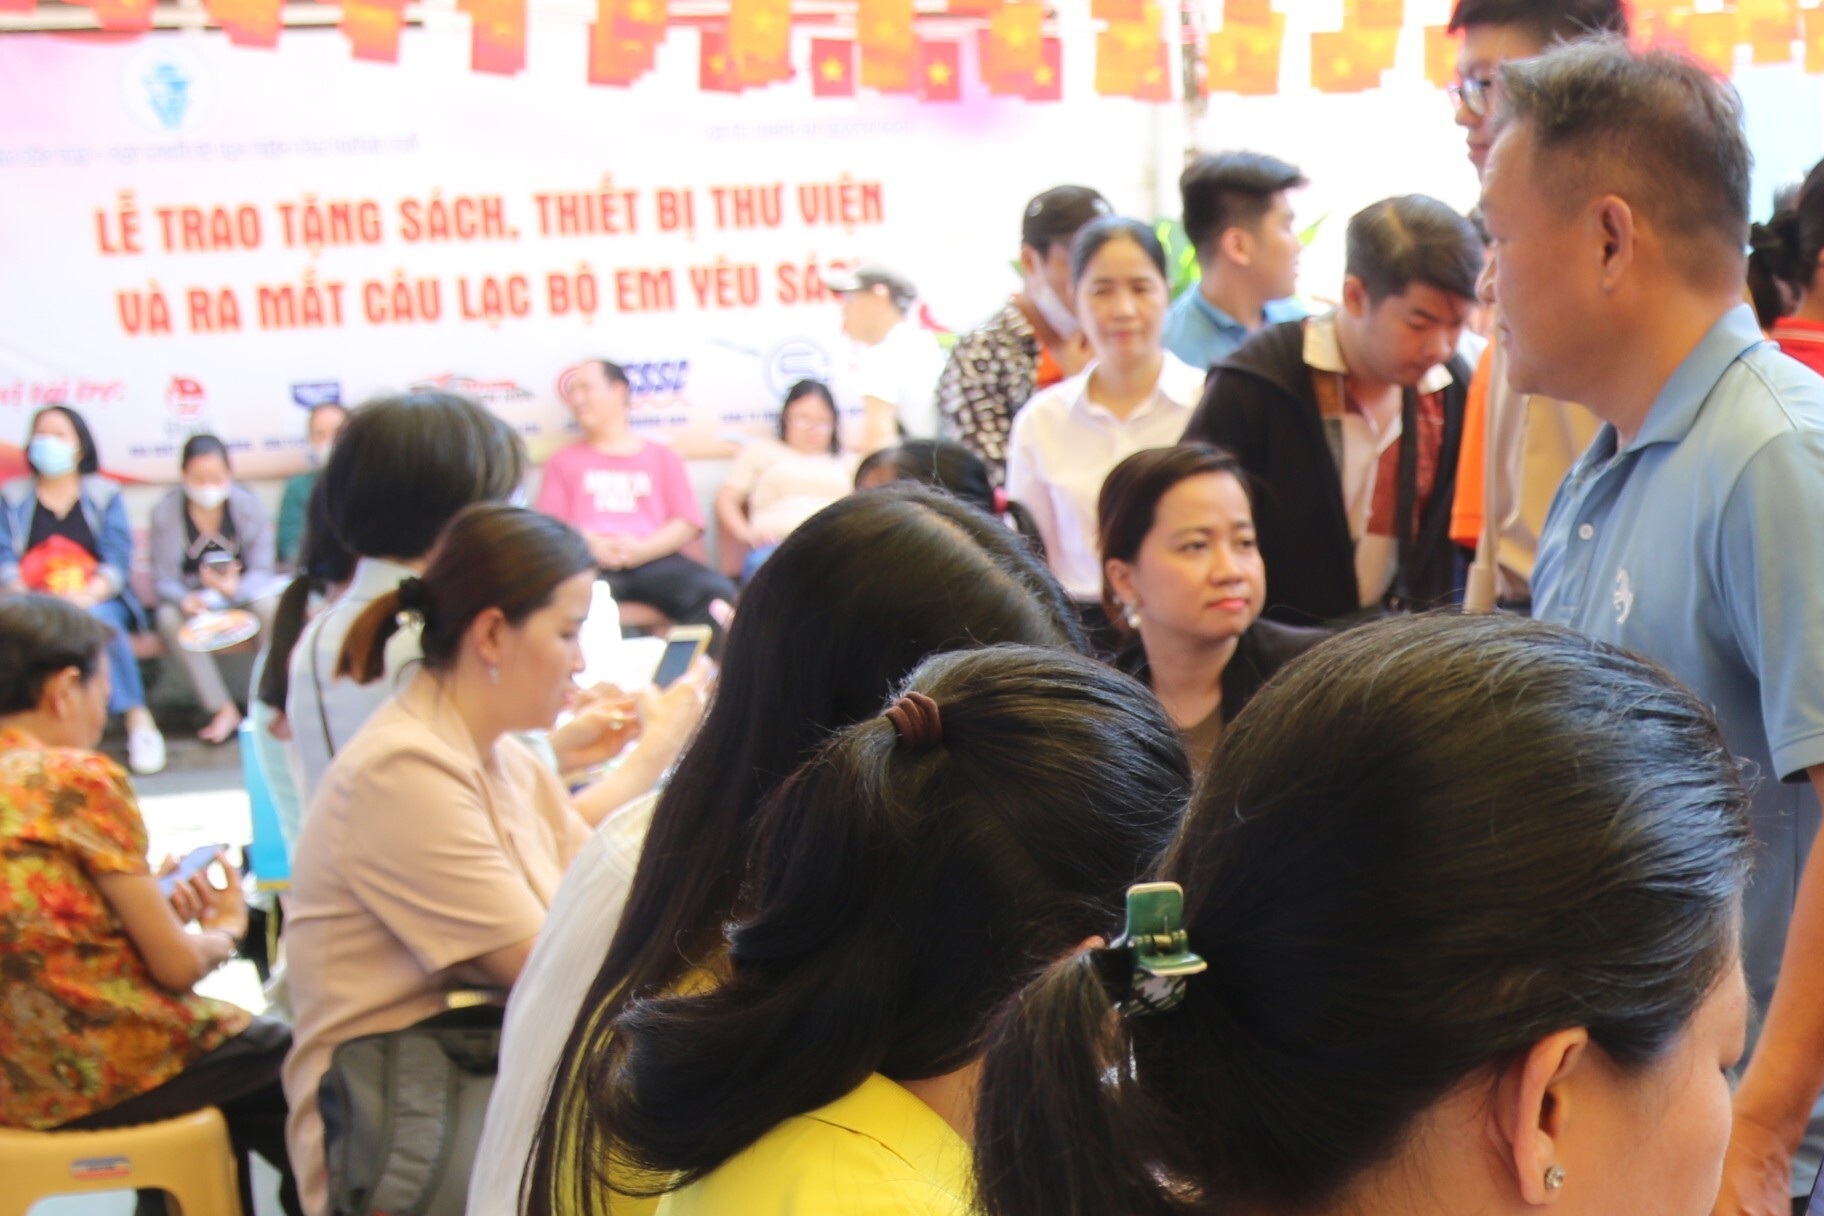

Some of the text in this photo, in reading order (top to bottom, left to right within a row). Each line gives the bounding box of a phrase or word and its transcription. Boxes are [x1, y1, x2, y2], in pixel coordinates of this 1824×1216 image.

[95, 190, 144, 255] LỄ
[155, 202, 263, 254] TRAO
[276, 192, 384, 259] TẶNG
[533, 171, 641, 237] THIẾT
[655, 187, 697, 240] BỊ
[710, 179, 786, 231] THƯ
[797, 172, 885, 235] VIỆN
[116, 279, 173, 336] VÀ
[186, 286, 243, 334] RA
[256, 266, 345, 330] MẮT
[458, 274, 532, 329] LẠC
[546, 258, 601, 325] BỘ
[615, 266, 677, 313] EM
[688, 254, 761, 309] YÊU
